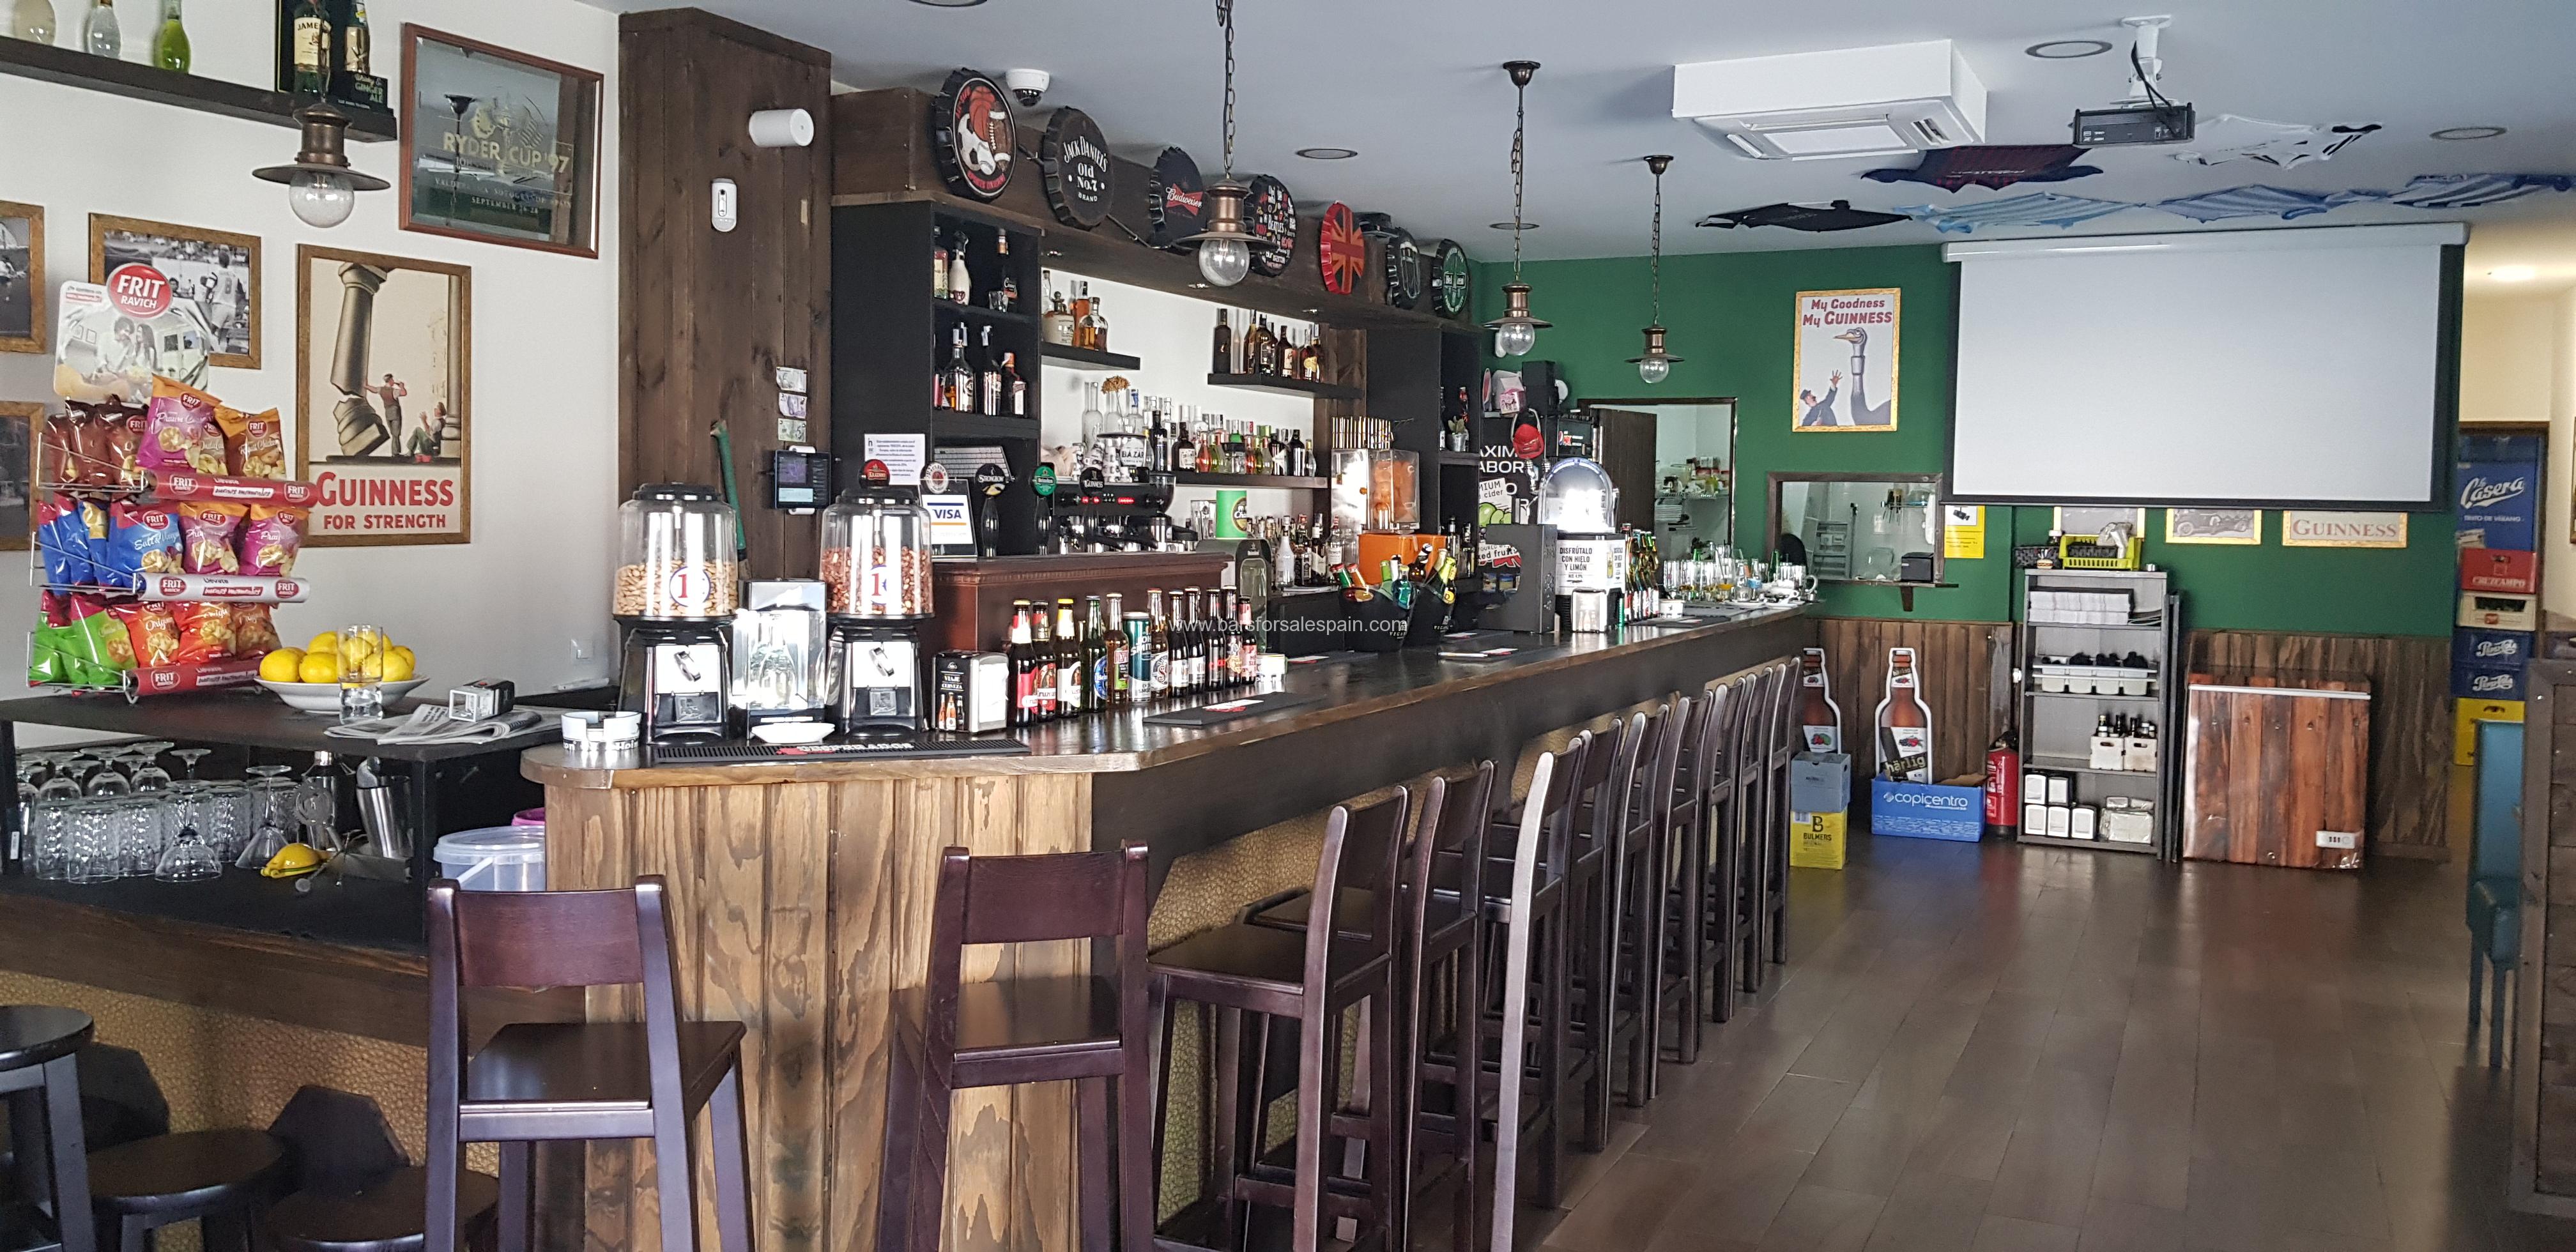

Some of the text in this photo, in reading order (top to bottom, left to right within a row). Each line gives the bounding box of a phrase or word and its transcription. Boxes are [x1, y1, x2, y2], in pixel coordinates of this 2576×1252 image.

[297, 22, 319, 31] JAME
[443, 132, 502, 160] RYDER
[510, 146, 542, 167] CUP
[544, 153, 570, 174] '97
[1063, 135, 1108, 172] JACK DANIEL'S
[1077, 162, 1094, 178] Old
[1078, 192, 1098, 202] BRAND
[471, 196, 516, 211] SEPTEMBER
[1268, 214, 1284, 234] BEATLES
[117, 274, 165, 299] FRIT
[121, 295, 157, 309] RAVICH
[1811, 298, 1885, 312] My Goodness
[1802, 310, 1892, 328] My GUINNESS
[182, 394, 201, 406] FRIT
[249, 422, 264, 431] FRIT
[1479, 461, 1524, 473] ABOR
[174, 477, 192, 487] FRIT
[1479, 481, 1501, 491] MIUM
[288, 485, 305, 494] FRIT
[317, 471, 454, 507] GUINNESS
[1483, 489, 1503, 498] cider
[2460, 477, 2524, 509] Casera
[146, 514, 164, 524] FRIT
[202, 513, 224, 523] FRIT
[933, 509, 962, 519] VISA
[323, 514, 446, 530] FOR STRENGTH
[2292, 519, 2396, 538] GUINNESS
[134, 537, 153, 551] Salt
[1560, 546, 1592, 554] DISFRÚTALO
[1570, 562, 1587, 571] LIMÓN
[162, 579, 181, 588] FRIT
[278, 583, 295, 591] FRIT
[155, 673, 174, 682] FRIT
[1885, 755, 1926, 773] härlig
[1895, 792, 1968, 807] copicentro
[1813, 816, 1823, 832] B
[1803, 832, 1832, 841] BULMERS
